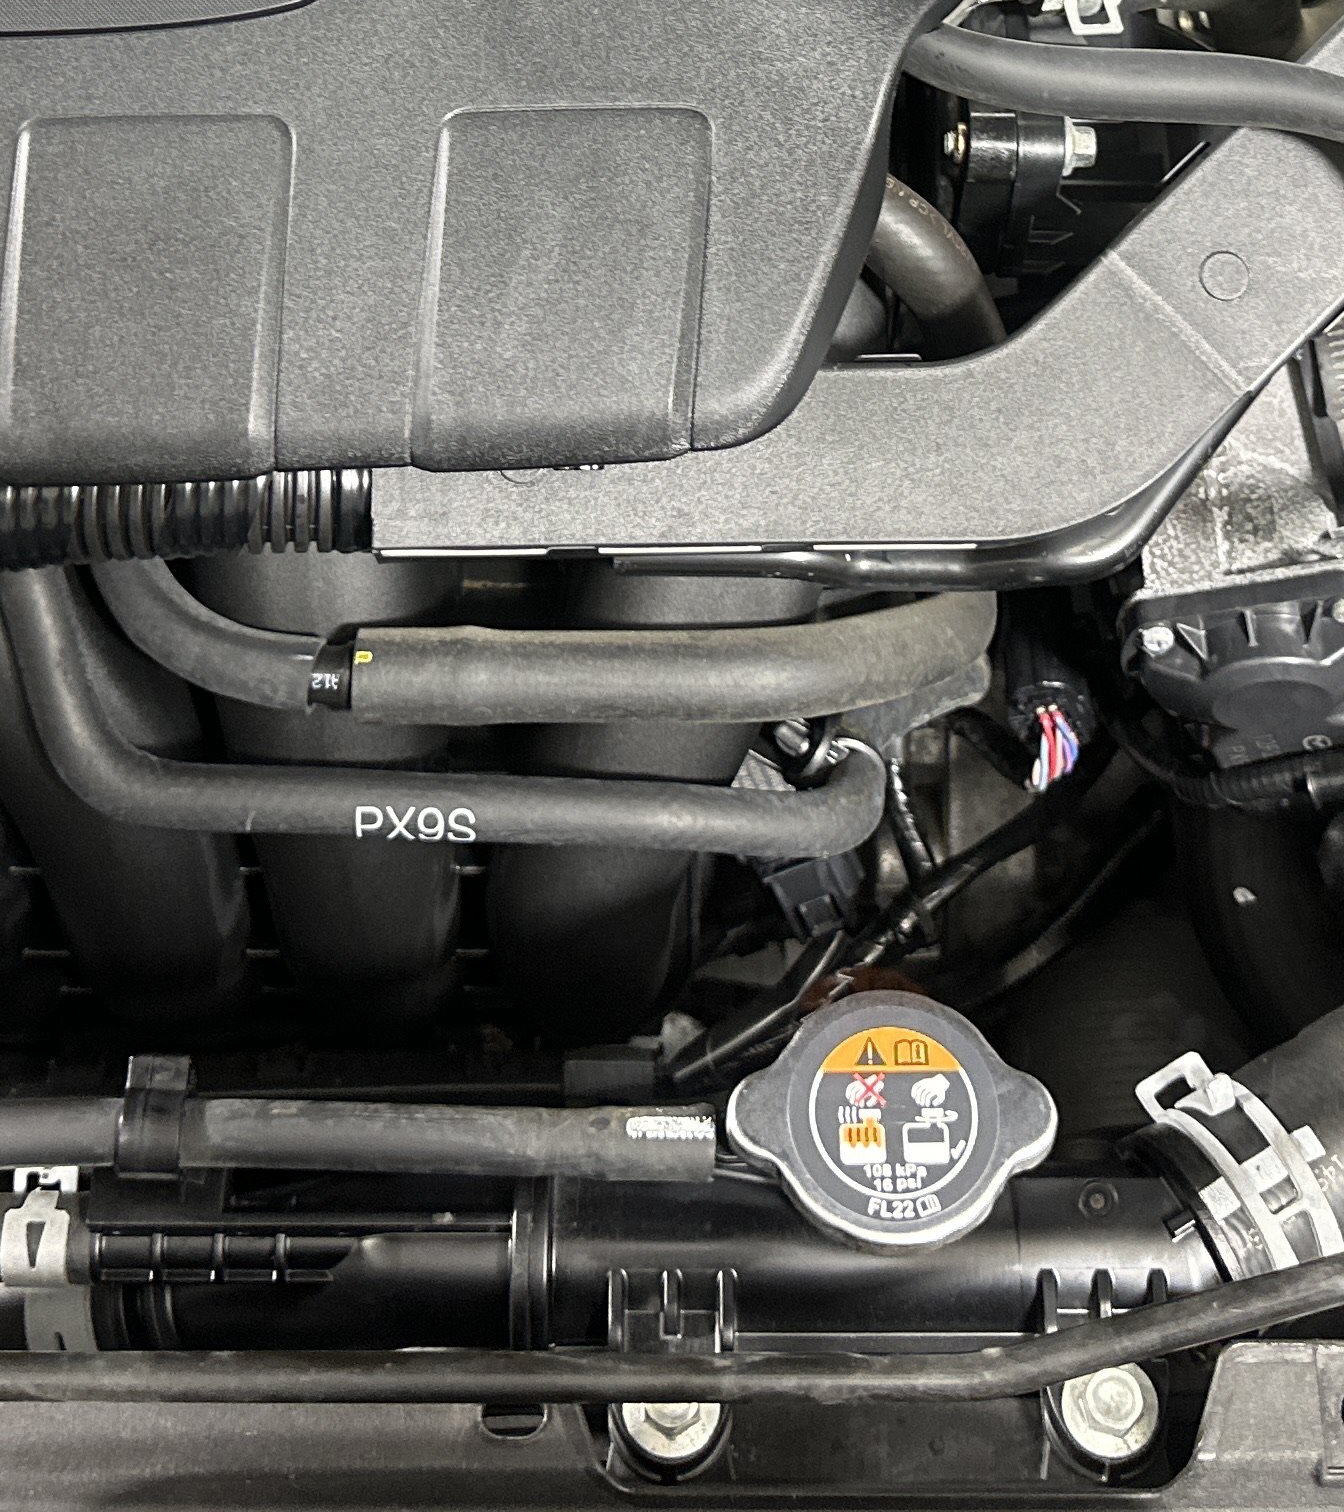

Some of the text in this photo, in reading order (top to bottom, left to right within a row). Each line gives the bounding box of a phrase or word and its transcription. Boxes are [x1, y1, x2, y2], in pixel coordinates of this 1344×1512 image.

[353, 804, 477, 844] PX9S
[863, 1162, 928, 1178] 108 kPa
[873, 1176, 922, 1192] 16 psi
[867, 1196, 916, 1219] FL22
